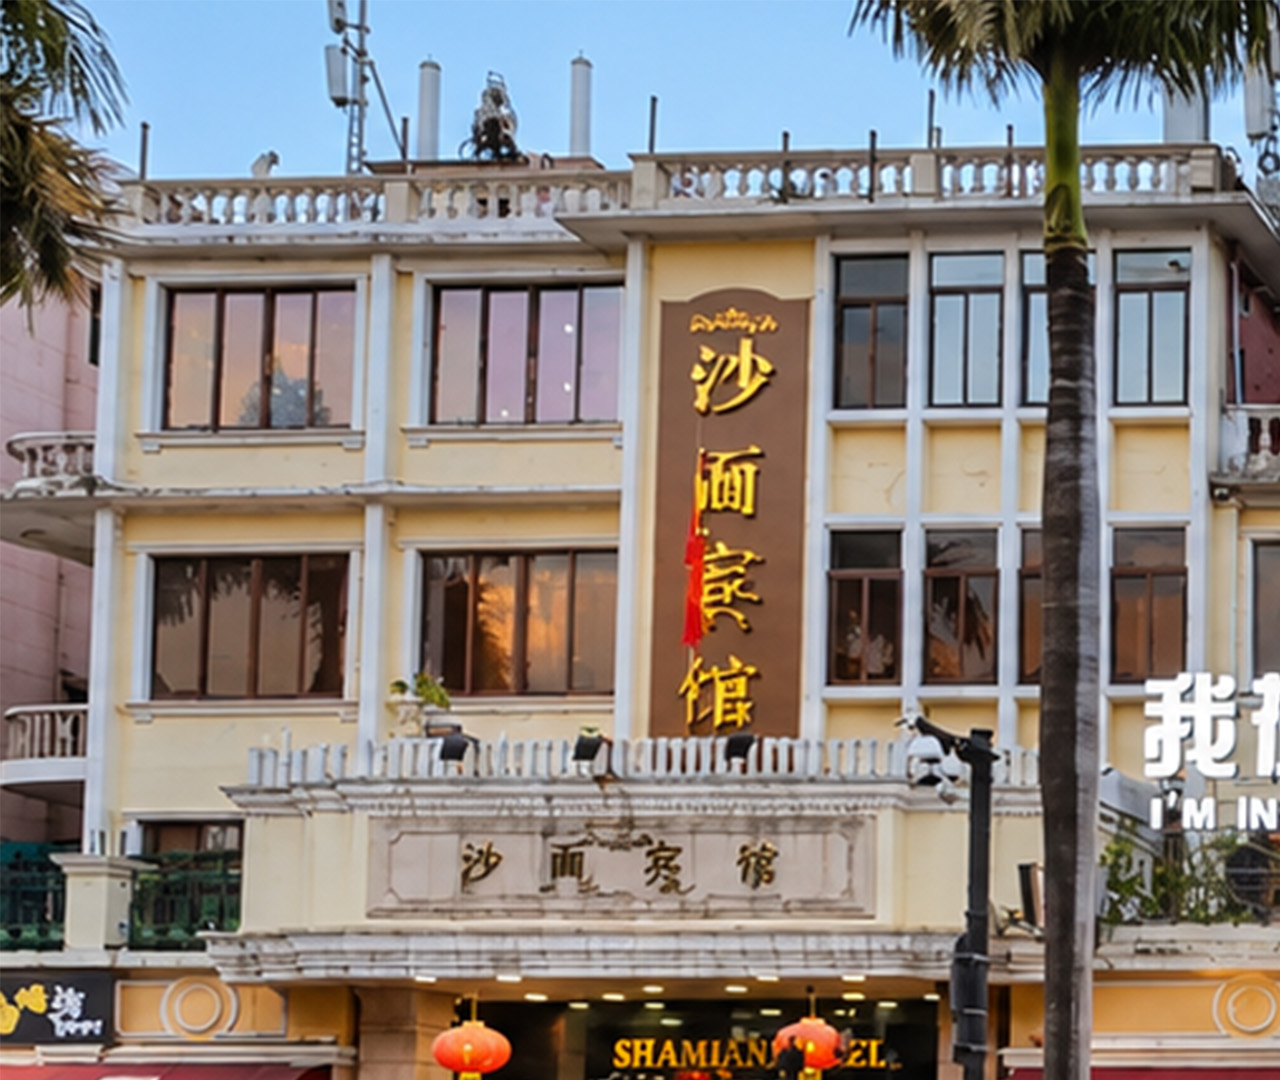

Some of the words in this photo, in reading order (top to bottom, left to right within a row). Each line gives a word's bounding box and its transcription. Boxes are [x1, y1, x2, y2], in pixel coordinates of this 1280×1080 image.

[1149, 789, 1216, 831] I'M
[1236, 795, 1279, 831] IN
[612, 1038, 768, 1069] SHAMIAN
